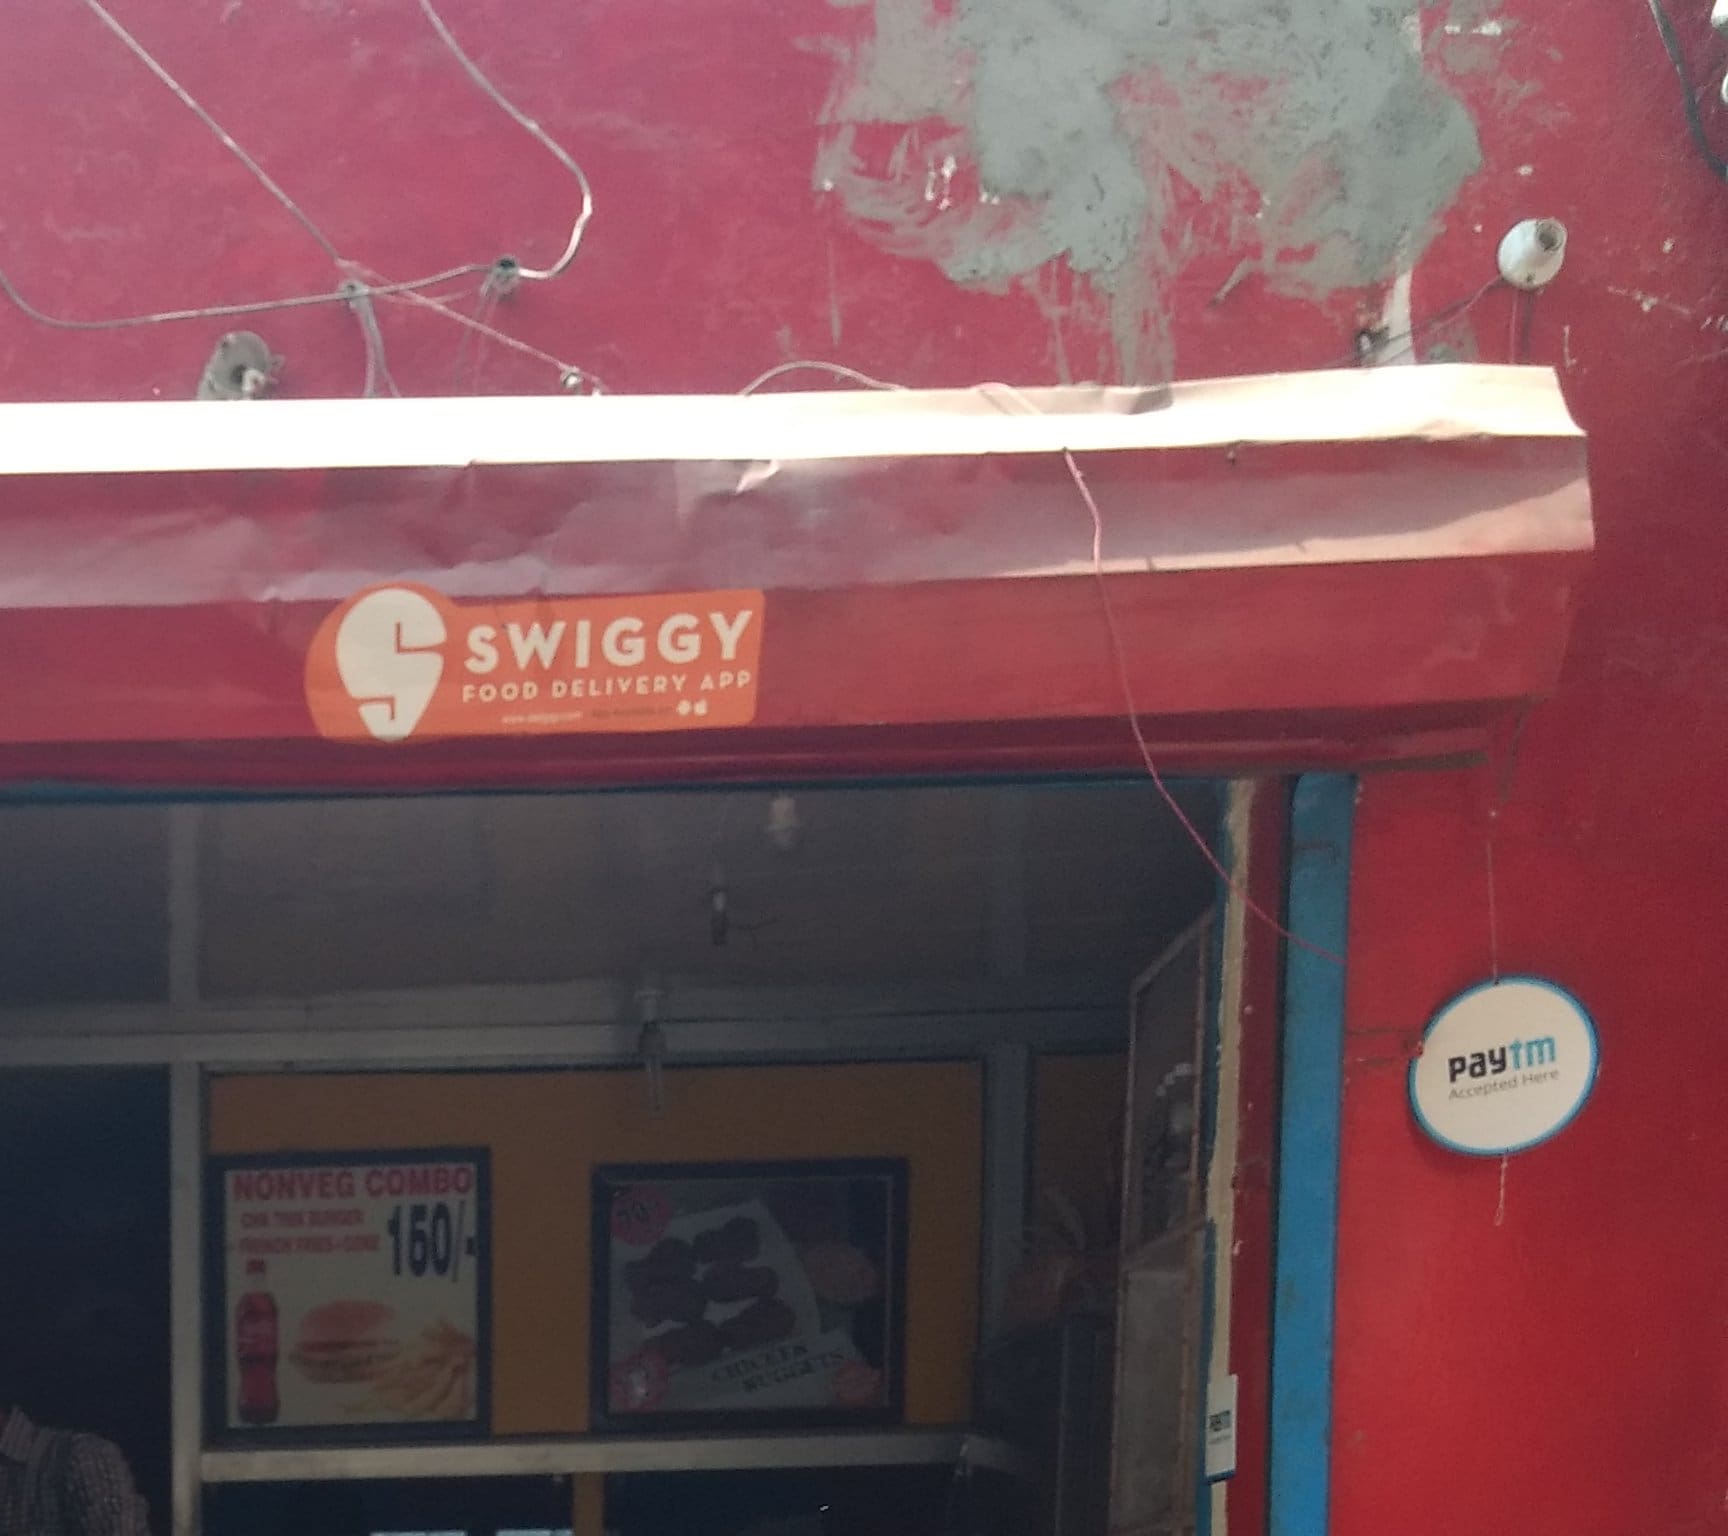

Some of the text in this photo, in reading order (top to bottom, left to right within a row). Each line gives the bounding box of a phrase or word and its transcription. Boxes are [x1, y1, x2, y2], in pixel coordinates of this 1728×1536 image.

[464, 610, 753, 675] SWIGGY
[462, 670, 752, 702] FOOD DELIVERY APP
[1449, 1069, 1559, 1100] Accepted Here
[233, 1167, 472, 1201] NONVEG COMBO
